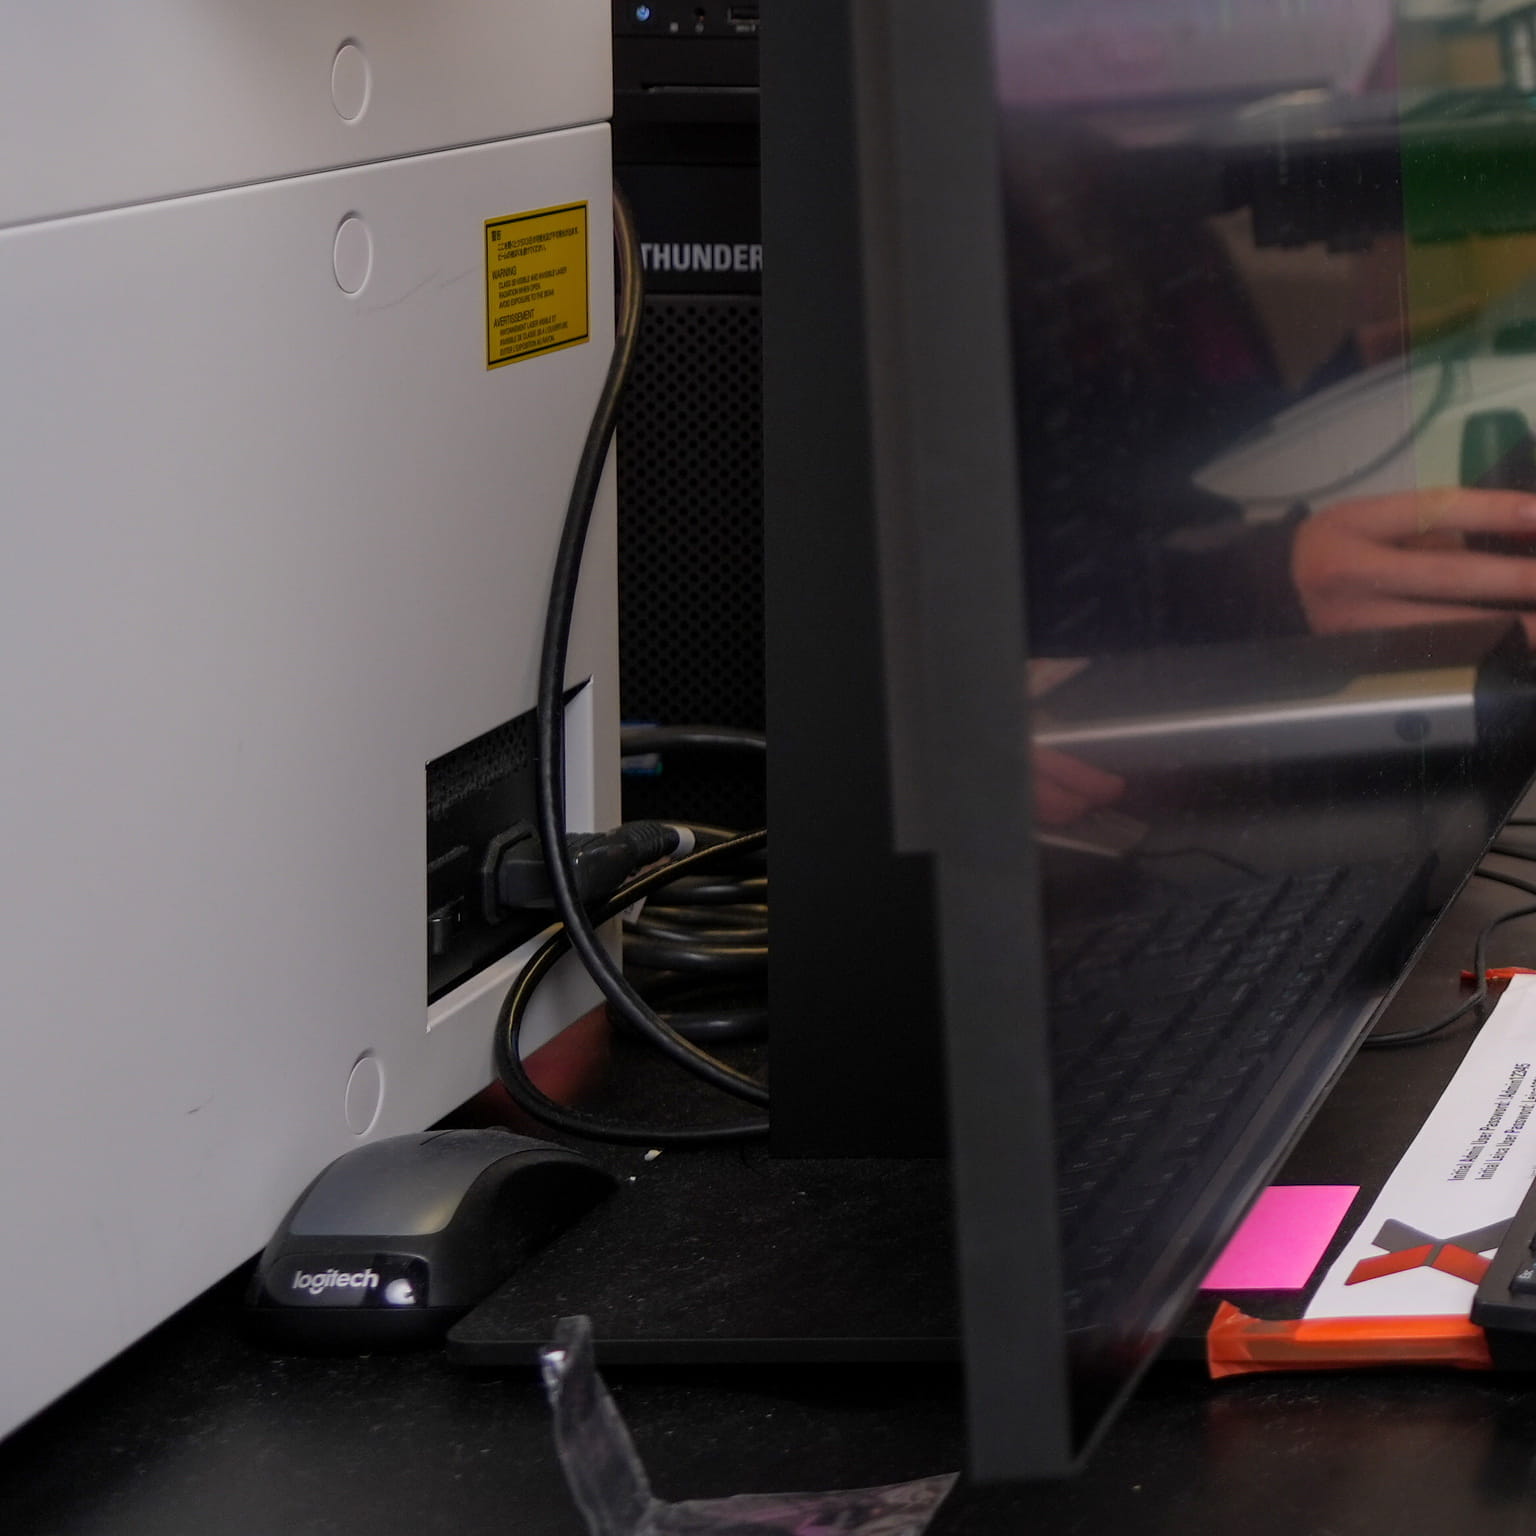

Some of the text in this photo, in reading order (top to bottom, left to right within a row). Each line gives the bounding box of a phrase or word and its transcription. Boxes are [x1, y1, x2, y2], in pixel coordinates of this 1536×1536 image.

[640, 243, 763, 272] THUNDER
[492, 266, 516, 280] WARNING
[493, 309, 535, 328] AVERTISSEMENT
[1470, 1131, 1494, 1145] User
[1496, 1134, 1519, 1147] User
[1458, 1145, 1486, 1162] Admin
[1485, 1147, 1510, 1162] Leica
[1447, 1162, 1473, 1181] Initial
[1474, 1162, 1501, 1181] Initial
[292, 1267, 380, 1295] logitech
